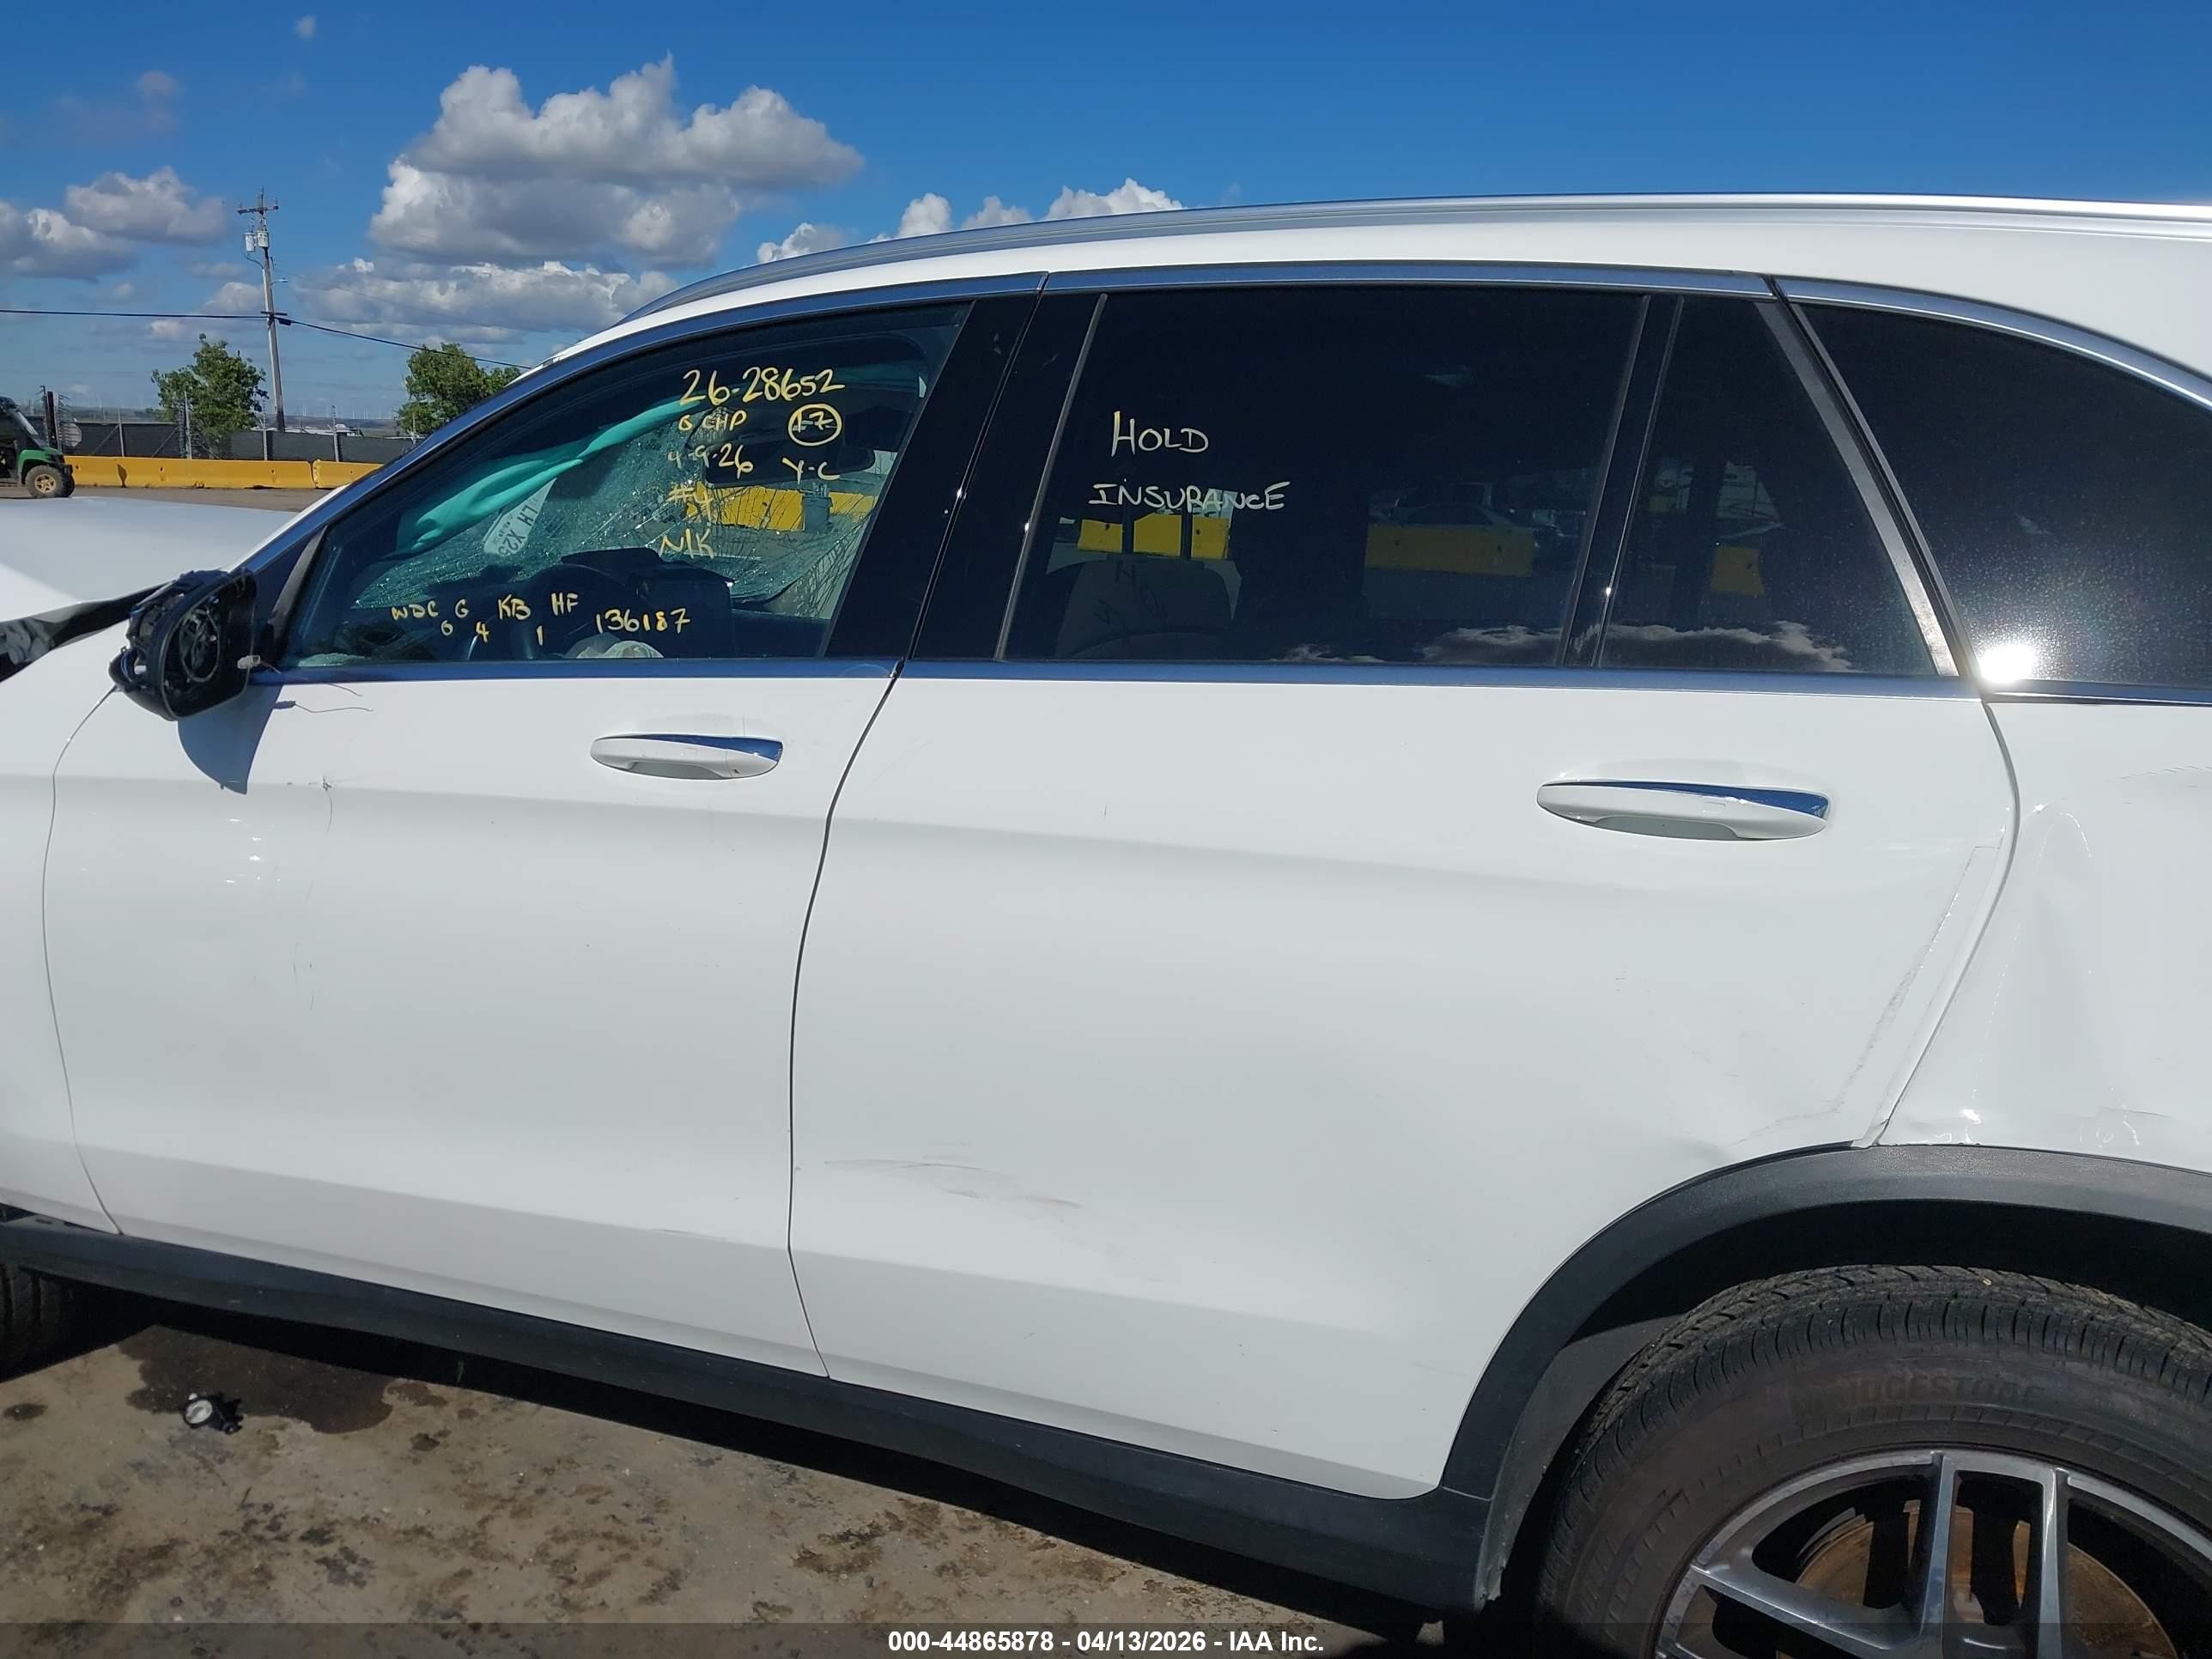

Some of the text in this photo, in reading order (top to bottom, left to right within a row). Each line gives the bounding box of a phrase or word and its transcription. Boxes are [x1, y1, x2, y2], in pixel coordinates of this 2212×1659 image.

[679, 366, 846, 406] 26-28652
[1111, 410, 1209, 458] HOLD
[1088, 481, 1291, 514] INSURANCE
[391, 592, 691, 635] WDC G KB HF 136187
[475, 621, 490, 644] 4
[535, 625, 544, 647] 1
